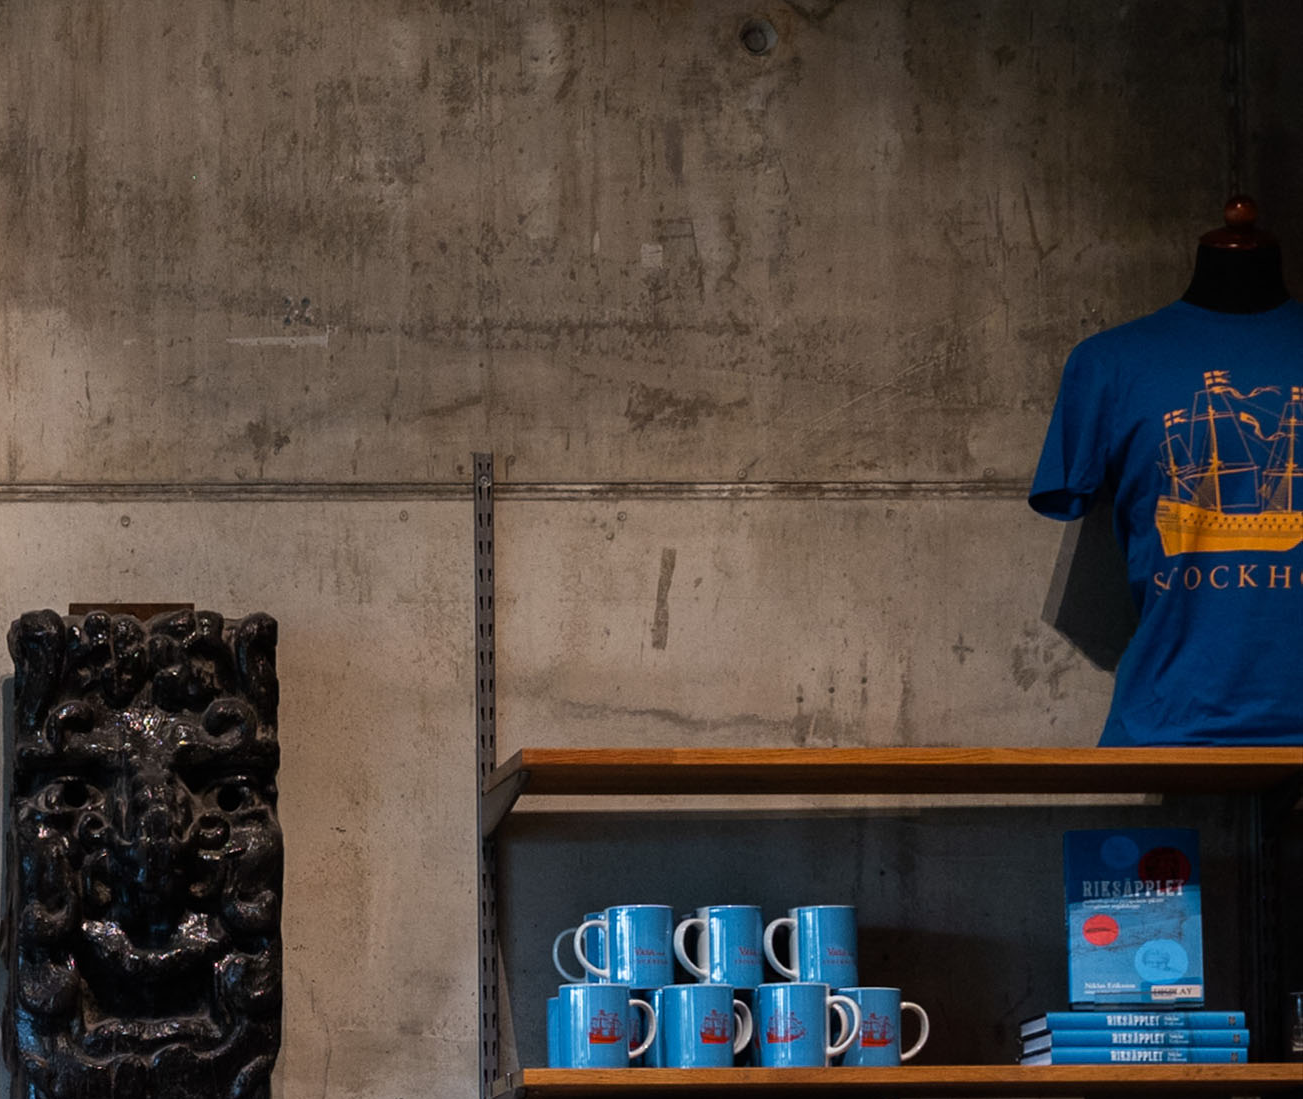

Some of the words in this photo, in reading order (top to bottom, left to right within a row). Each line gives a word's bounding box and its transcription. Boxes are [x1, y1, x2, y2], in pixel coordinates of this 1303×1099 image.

[1154, 563, 1303, 596] STOCKH
[1082, 878, 1185, 897] RIKSÄPPLET
[1106, 1014, 1161, 1027] RIKSÄPPLET
[1112, 1032, 1165, 1045] RIKSÄPPLET
[1110, 1049, 1163, 1062] RIKSÄPPLET
